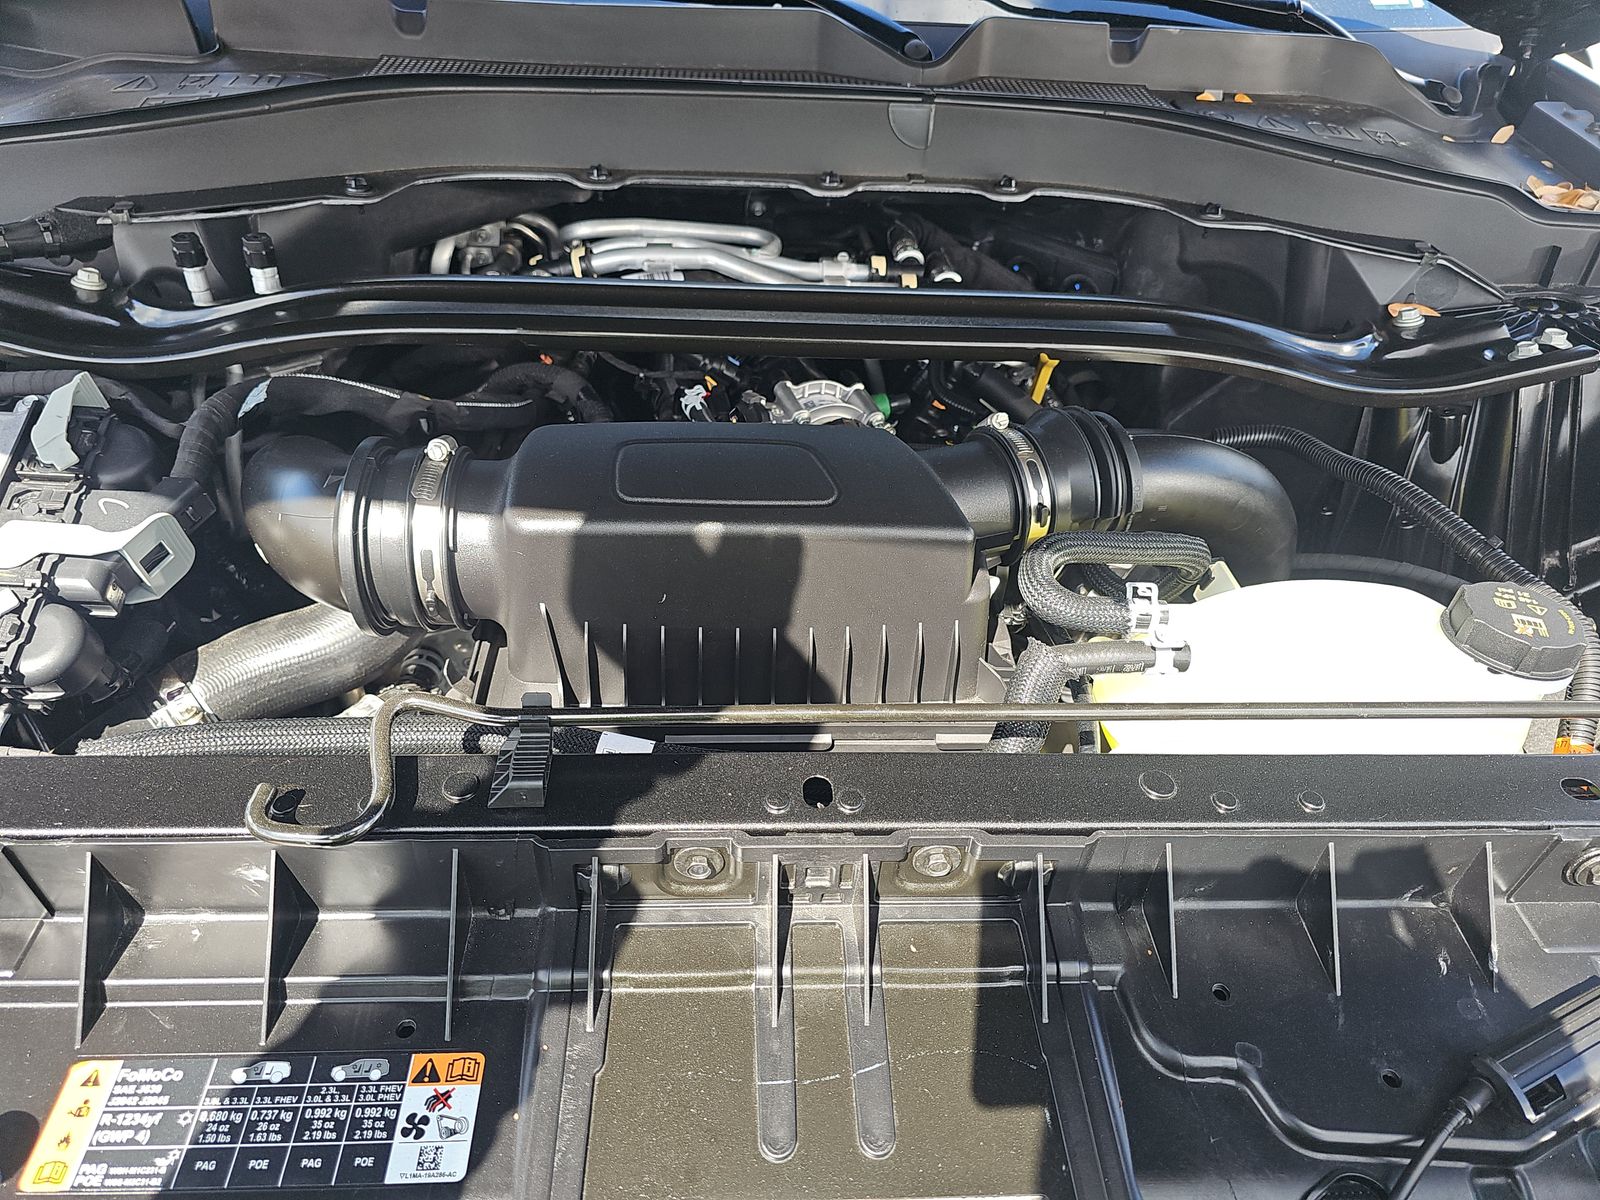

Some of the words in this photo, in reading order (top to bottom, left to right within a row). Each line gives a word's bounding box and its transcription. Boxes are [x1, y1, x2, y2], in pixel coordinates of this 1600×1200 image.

[116, 1067, 184, 1083] FoMoCo
[112, 1084, 137, 1095] SAE
[360, 1086, 378, 1094] 3.3L
[379, 1085, 404, 1093] FHEV
[223, 1097, 230, 1105] &
[231, 1097, 249, 1105] 3.3L
[255, 1096, 273, 1104] 3.3L
[274, 1096, 299, 1104] FHEV
[306, 1095, 324, 1103] 3.0L
[358, 1094, 376, 1102] 3.0L
[377, 1093, 402, 1101] PHEV
[199, 1110, 229, 1122] 0.680
[230, 1110, 244, 1123] kg
[250, 1110, 279, 1121] 0.737
[279, 1110, 294, 1122] kg
[304, 1108, 333, 1119] 0.992
[334, 1108, 348, 1120] kg
[354, 1107, 383, 1118] 0.992
[384, 1107, 398, 1119] kg
[99, 1112, 164, 1128] R-1234yf
[311, 1120, 323, 1129] 35
[323, 1121, 335, 1129] oz
[361, 1119, 373, 1129] 35
[374, 1120, 386, 1128] oz
[206, 1123, 218, 1132] 24
[218, 1124, 230, 1132] oz
[256, 1122, 268, 1131] 26
[269, 1123, 281, 1131] oz
[92, 1129, 135, 1146] (GWP
[198, 1133, 217, 1143] 1.50
[217, 1133, 231, 1142] lbs
[249, 1133, 267, 1142] 1.63
[268, 1132, 282, 1142] lbs
[302, 1130, 322, 1140] 2.19
[323, 1130, 337, 1140] lbs
[353, 1130, 373, 1140] 2.19
[374, 1129, 388, 1139] lbs
[194, 1160, 217, 1171] PAG
[247, 1159, 270, 1170] POE
[300, 1158, 322, 1168] PAG
[354, 1157, 375, 1167] POE
[79, 1163, 109, 1176] PAG
[73, 1174, 105, 1187] POE
